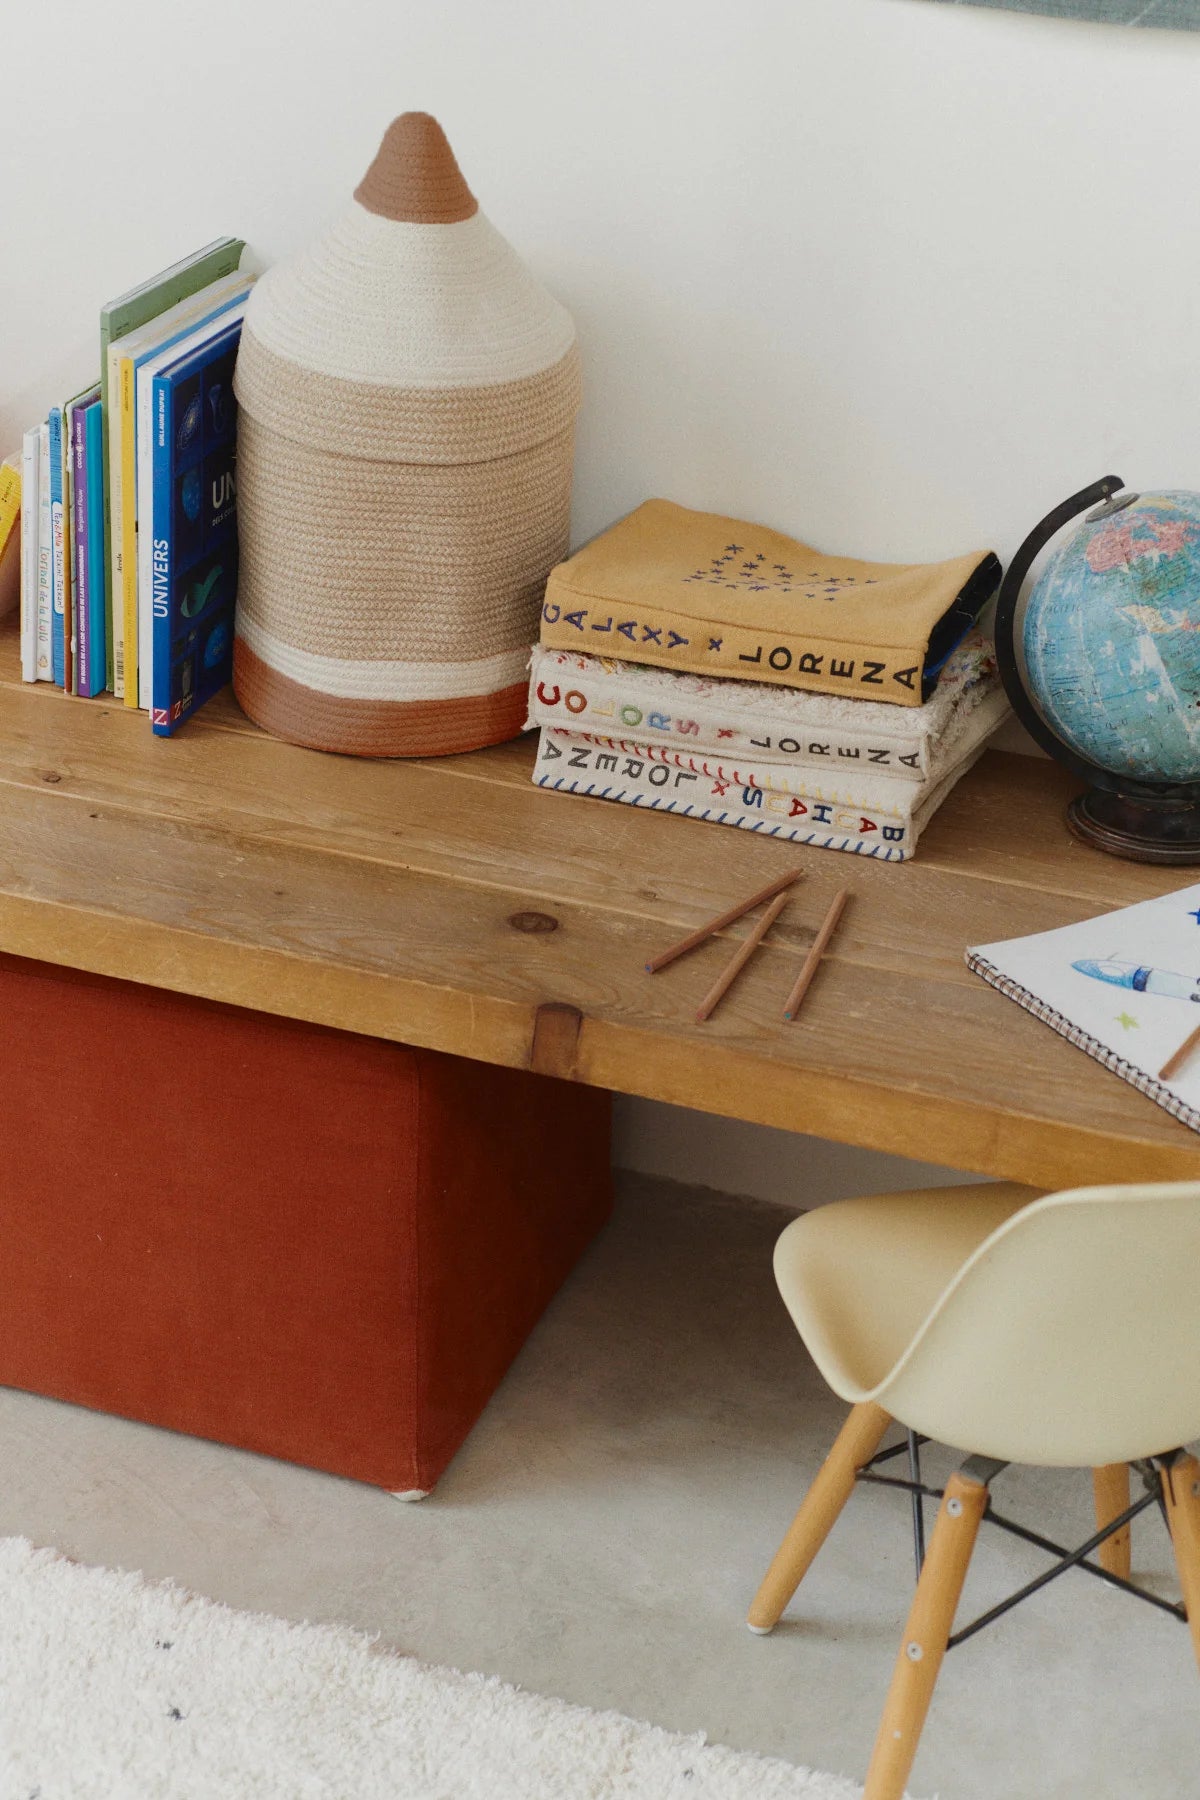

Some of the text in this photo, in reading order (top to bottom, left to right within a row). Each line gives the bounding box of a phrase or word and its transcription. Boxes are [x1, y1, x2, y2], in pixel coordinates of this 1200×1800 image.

[39, 591, 48, 602] de
[153, 538, 169, 618] UNIVERS
[39, 605, 49, 615] la
[543, 602, 689, 648] GALAXY
[738, 645, 919, 690] LORENA
[154, 708, 168, 726] Z
[536, 681, 701, 737] COLORS
[750, 736, 920, 769] LORENA
[541, 738, 698, 788] LORENA
[742, 786, 905, 842] BAUHAUS
